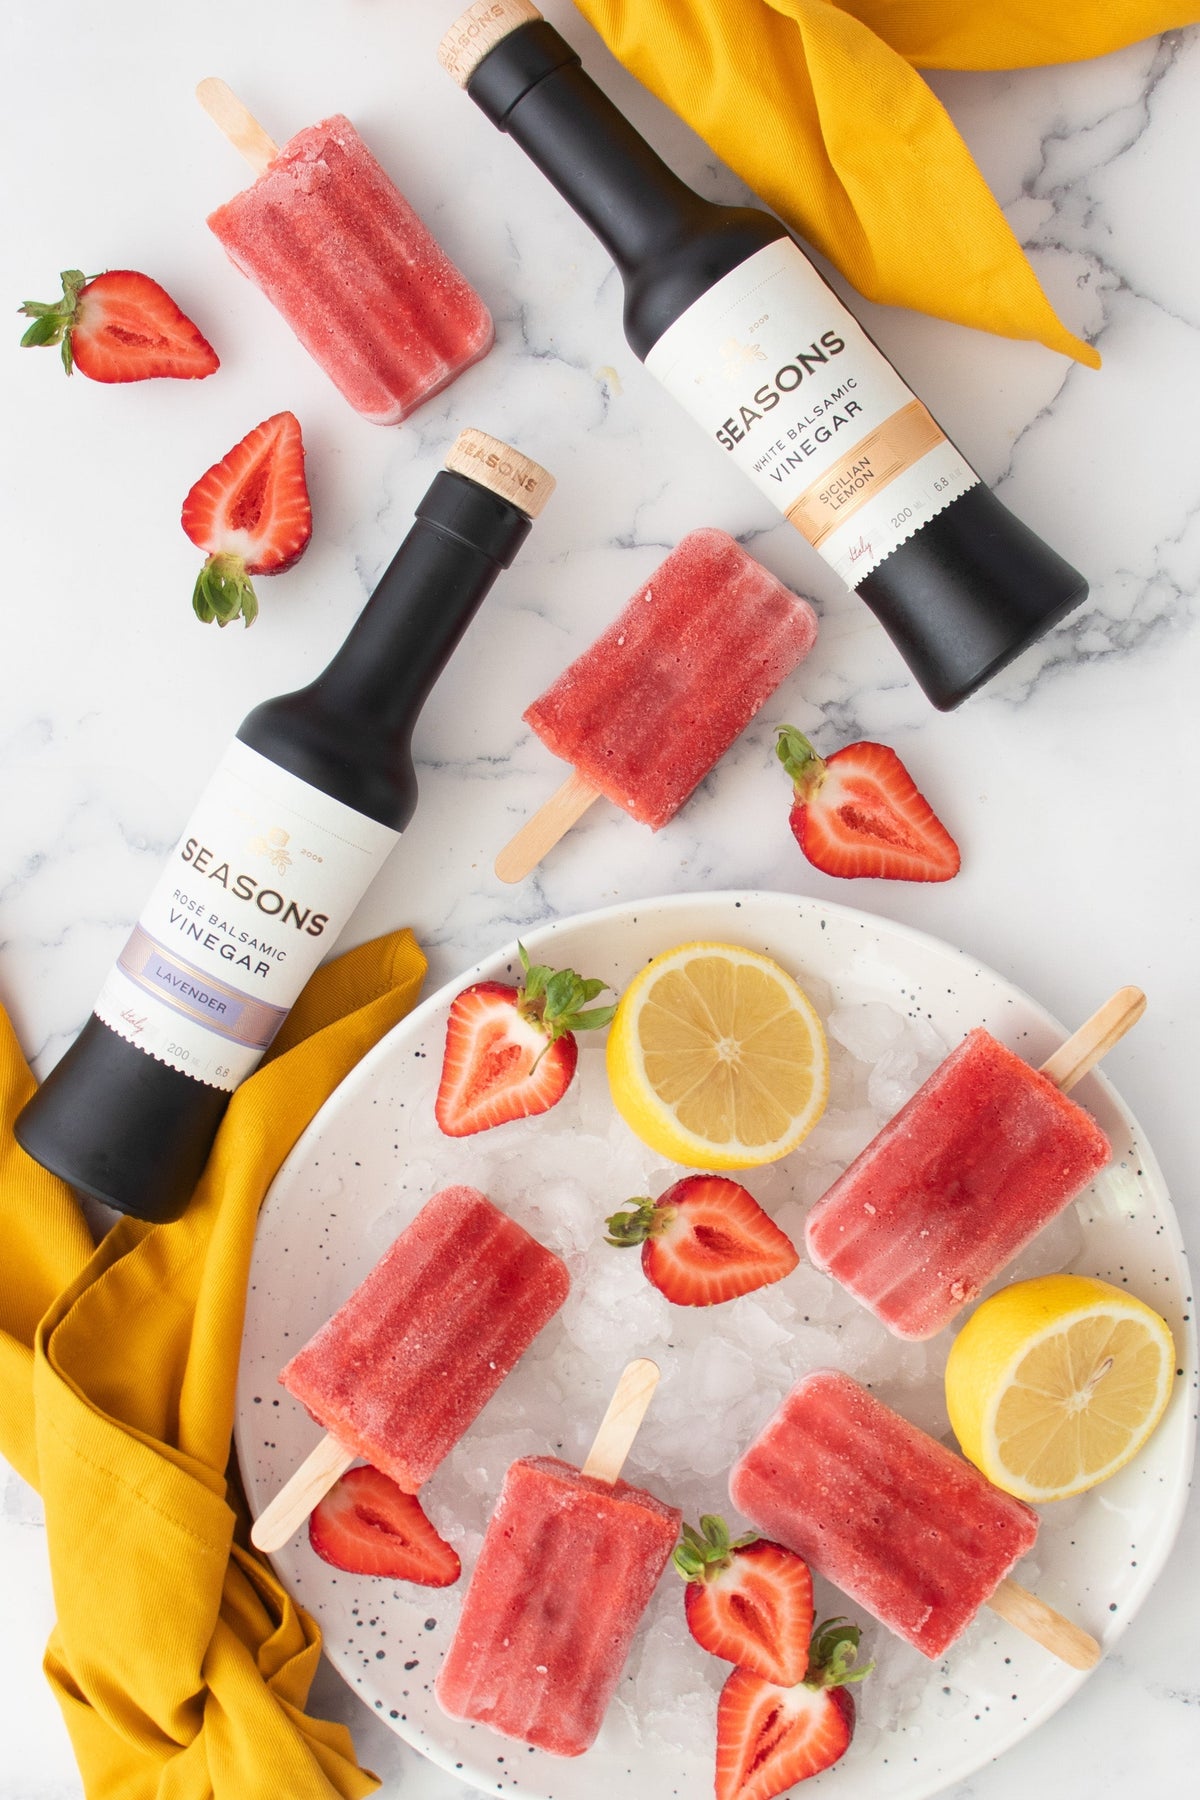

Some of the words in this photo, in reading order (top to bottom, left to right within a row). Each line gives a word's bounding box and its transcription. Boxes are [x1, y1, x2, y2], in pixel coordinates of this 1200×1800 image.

[715, 330, 845, 452] SEASONS
[752, 439, 786, 473] WHITE
[786, 378, 858, 440] BALSAMIC
[769, 400, 863, 482] VINEGAR
[457, 439, 537, 493] SEASONS
[819, 456, 871, 505] SICILIAN
[830, 469, 874, 511] LEMON
[890, 507, 913, 529] 200
[933, 476, 949, 493] 6.8
[849, 535, 874, 563] Italy
[181, 837, 330, 937] SEASONS
[169, 908, 271, 978] VINEGAR
[173, 888, 206, 917] ROSÉ
[208, 914, 287, 962] BALSAMIC
[155, 966, 227, 1014] LAVENDER
[167, 1042, 190, 1061] 200
